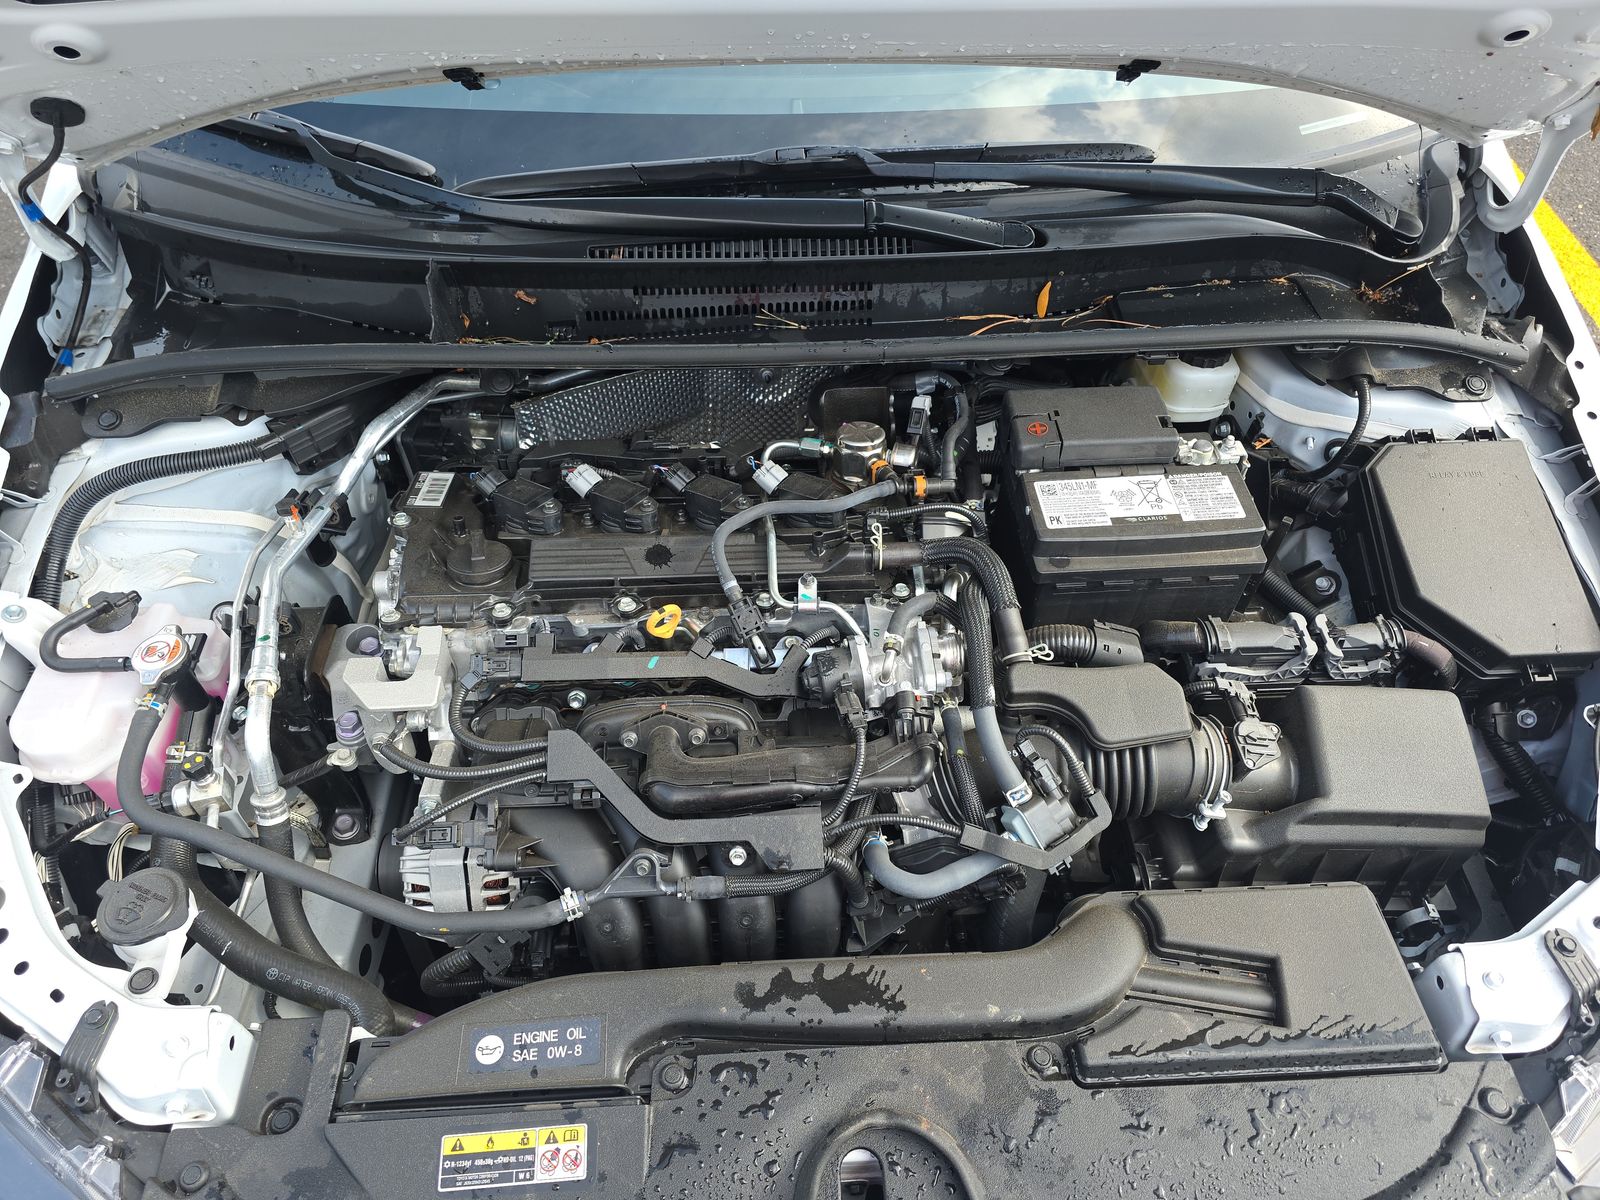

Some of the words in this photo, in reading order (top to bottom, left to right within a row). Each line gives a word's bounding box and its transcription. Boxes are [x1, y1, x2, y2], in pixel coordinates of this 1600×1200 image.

[1049, 515, 1063, 525] PK
[512, 1029, 559, 1045] ENGINE
[566, 1027, 587, 1040] OIL
[512, 1047, 538, 1062] SAE
[547, 1044, 582, 1059] 0W-8
[518, 1172, 525, 1180] W
